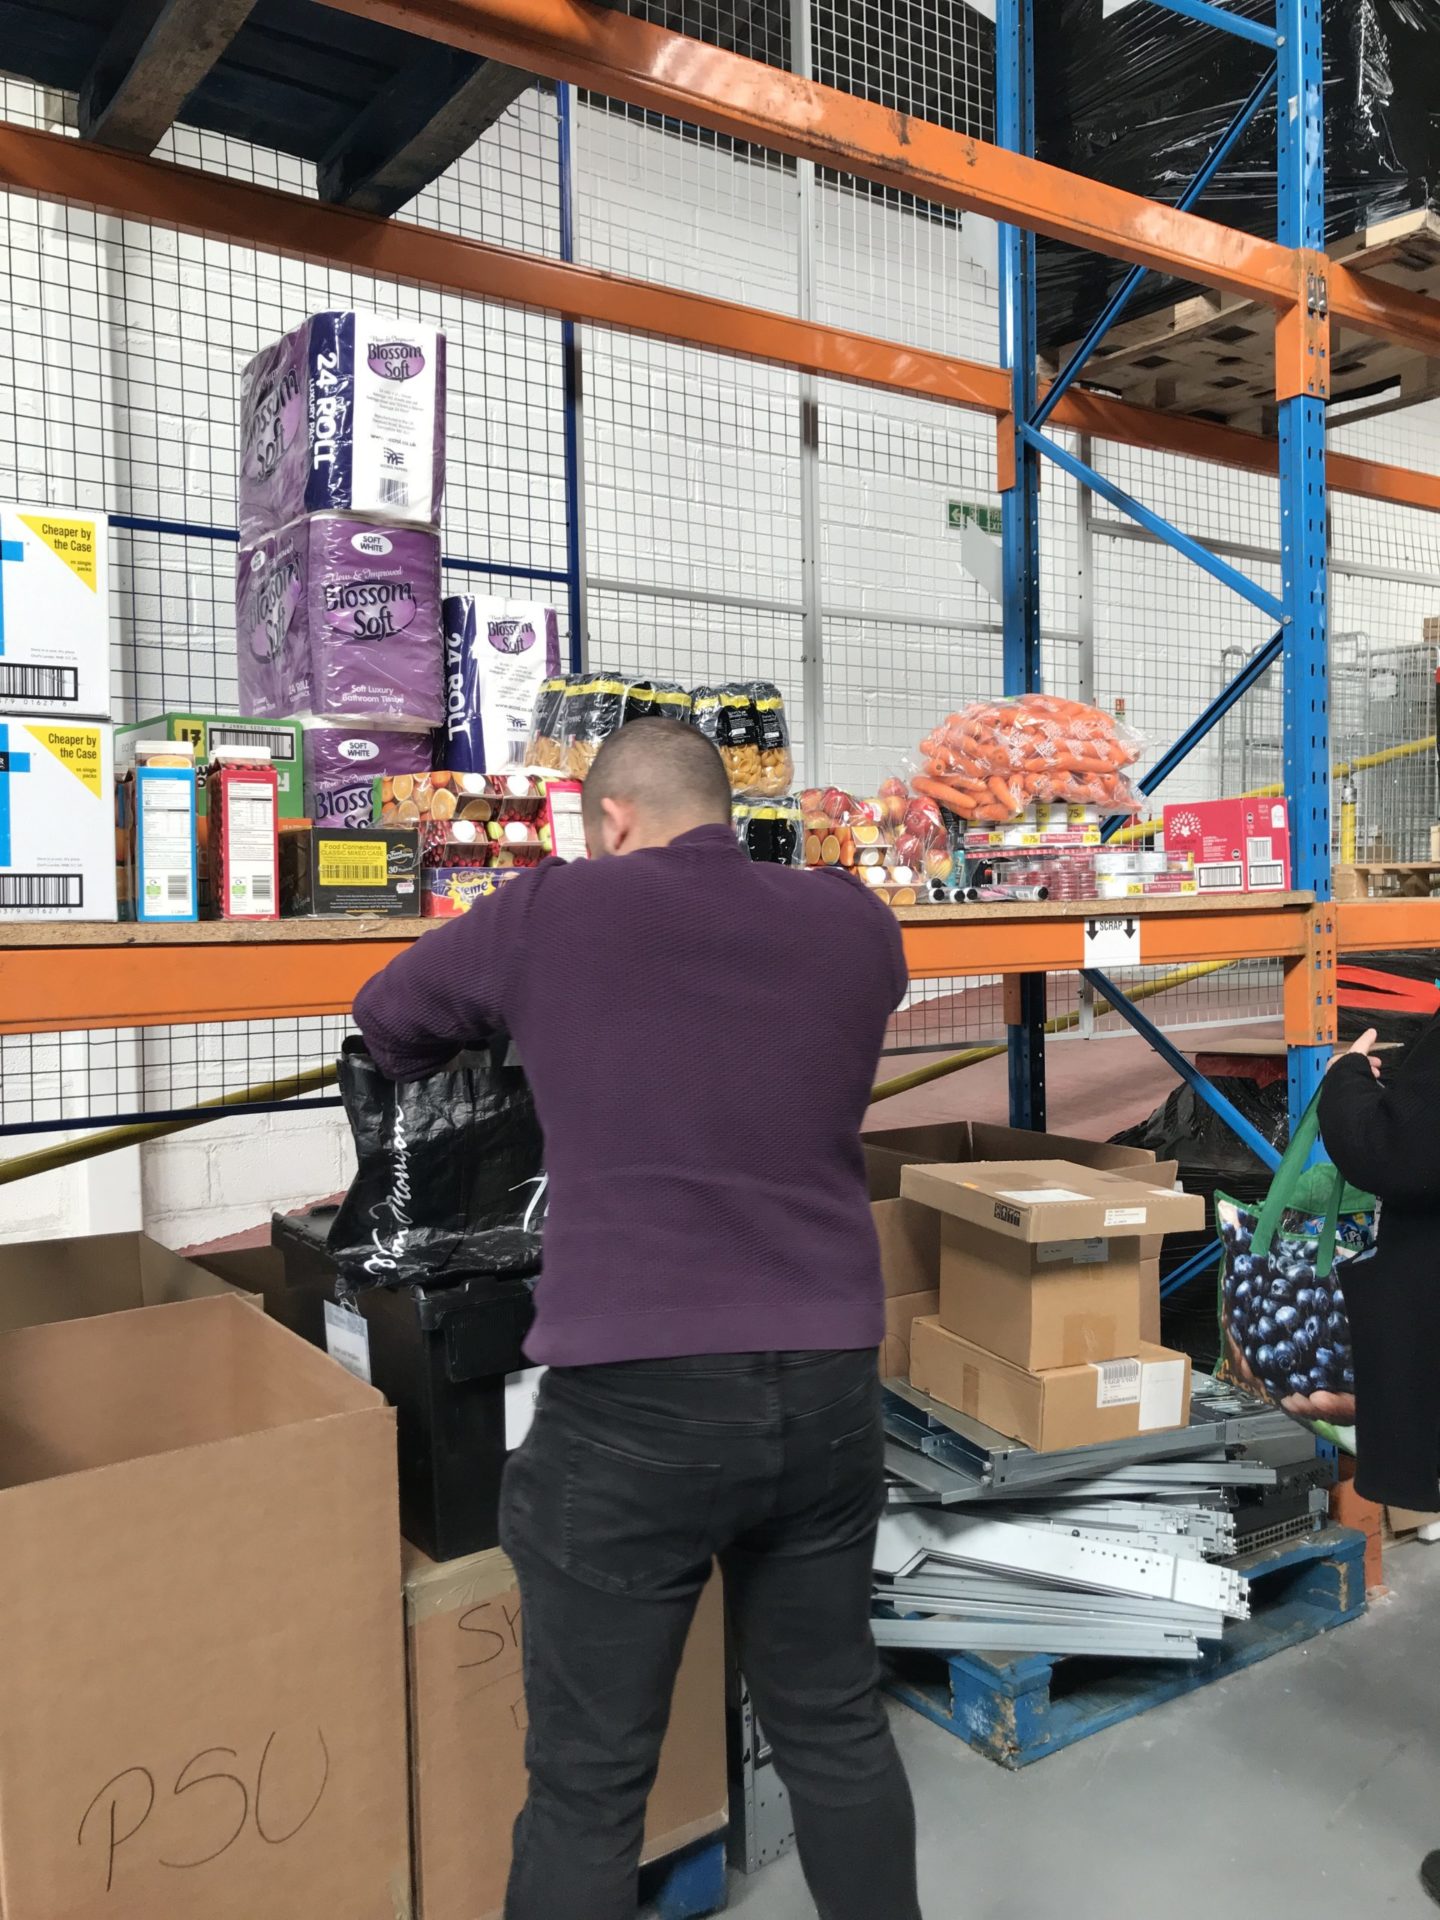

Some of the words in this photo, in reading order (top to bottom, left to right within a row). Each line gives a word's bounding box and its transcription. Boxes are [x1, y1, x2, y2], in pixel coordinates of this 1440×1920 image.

[368, 343, 422, 360] Blossom
[316, 352, 338, 389] 24
[385, 360, 410, 383] Soft
[314, 397, 336, 470] ROLL
[42, 523, 78, 538] Cheaper
[81, 528, 91, 541] by
[362, 535, 381, 544] SOFT
[54, 539, 68, 550] the
[70, 540, 92, 552] Case
[360, 542, 383, 553] WHITE
[324, 582, 412, 611] Blossom
[353, 606, 395, 642] Soft
[446, 632, 463, 667] 24
[368, 685, 395, 696] Luxury
[448, 673, 466, 742] ROLL
[48, 733, 84, 747] Cheaper
[86, 735, 96, 748] by
[60, 748, 74, 758] the
[76, 748, 97, 760] Case
[347, 750, 371, 758] WHITE
[342, 843, 382, 851] Connections
[1099, 920, 1123, 931] SCRAP
[77, 1726, 329, 1892] PSU
